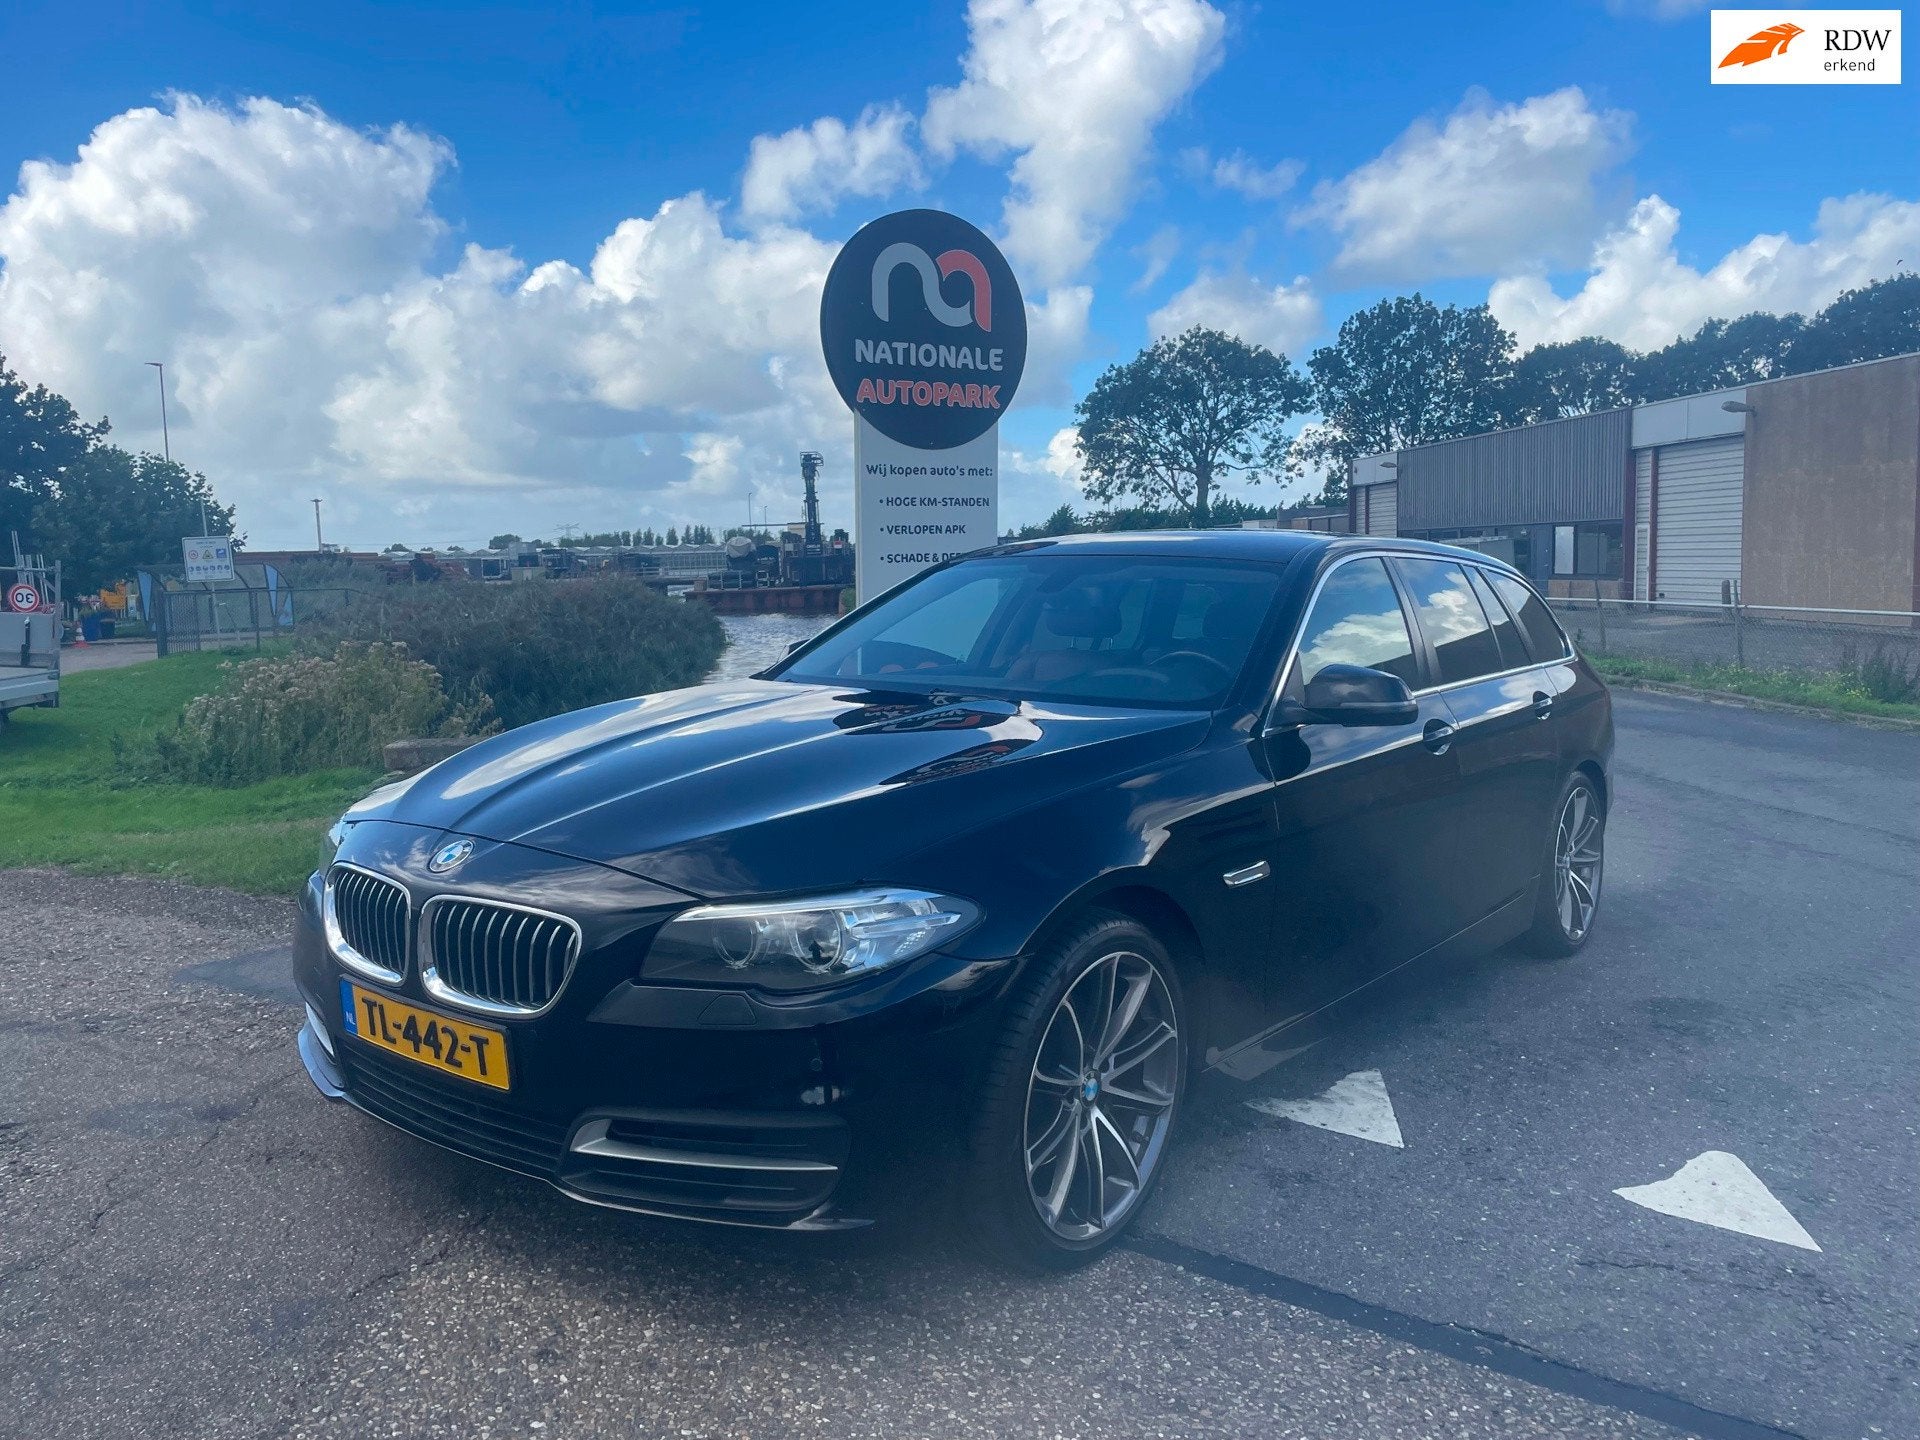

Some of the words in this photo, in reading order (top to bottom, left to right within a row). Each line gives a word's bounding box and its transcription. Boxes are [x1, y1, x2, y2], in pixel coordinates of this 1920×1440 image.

[855, 338, 1003, 371] NATIONALE
[856, 378, 1001, 409] AUTOPARK
[866, 464, 887, 477] Wij
[890, 465, 927, 477] kopen
[930, 466, 965, 476] auto's
[968, 466, 993, 476] met:
[886, 497, 917, 507] HOGE
[919, 497, 990, 507] KM-STANDEN
[886, 525, 943, 535] VERLOPEN
[945, 525, 966, 534] APK
[887, 553, 930, 563] SCHADE
[932, 553, 939, 563] &
[15, 592, 34, 604] 30
[361, 996, 490, 1076] TL-442-T
